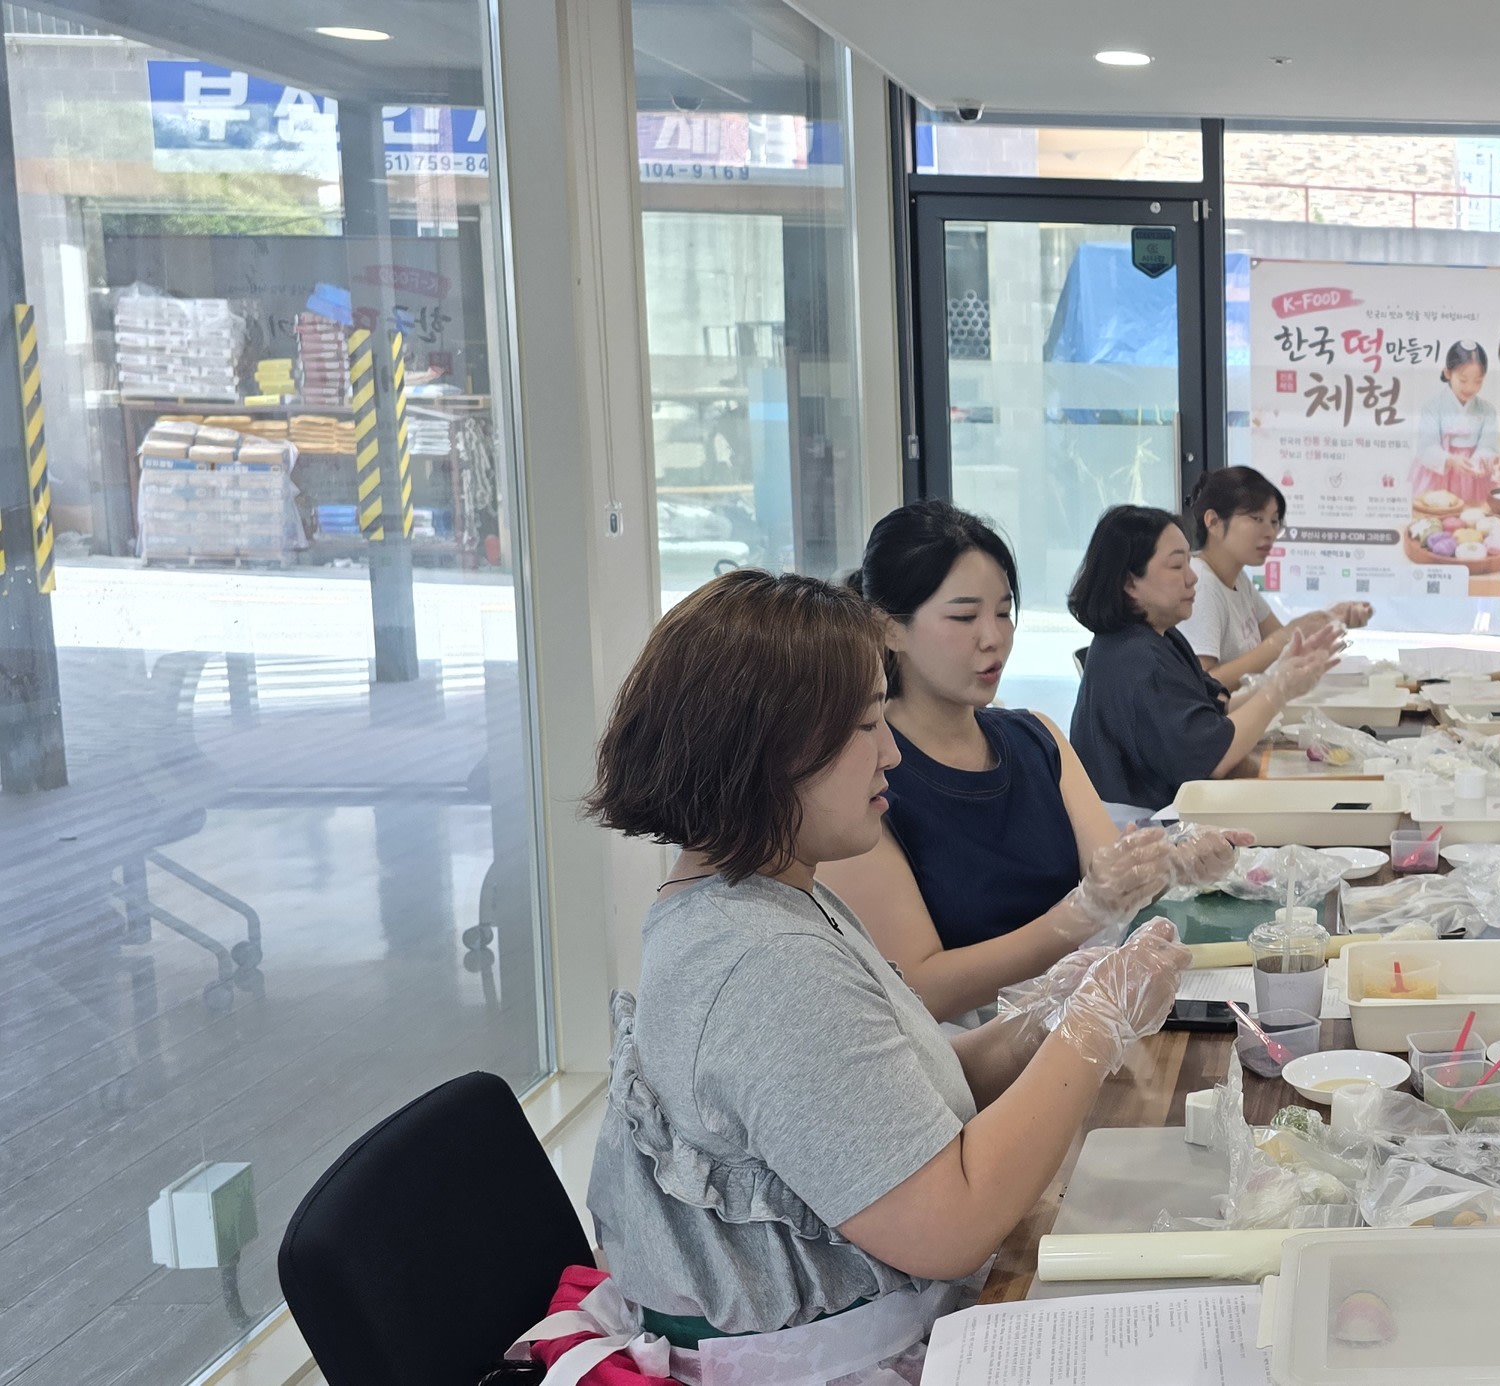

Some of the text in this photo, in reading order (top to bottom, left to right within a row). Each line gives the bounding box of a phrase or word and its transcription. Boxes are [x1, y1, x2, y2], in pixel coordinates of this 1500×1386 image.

[642, 162, 751, 181] 104-9169
[1283, 290, 1341, 313] K-FOOD
[1274, 325, 1441, 374] 한국 떡 만들기
[1304, 372, 1406, 427] 체험
